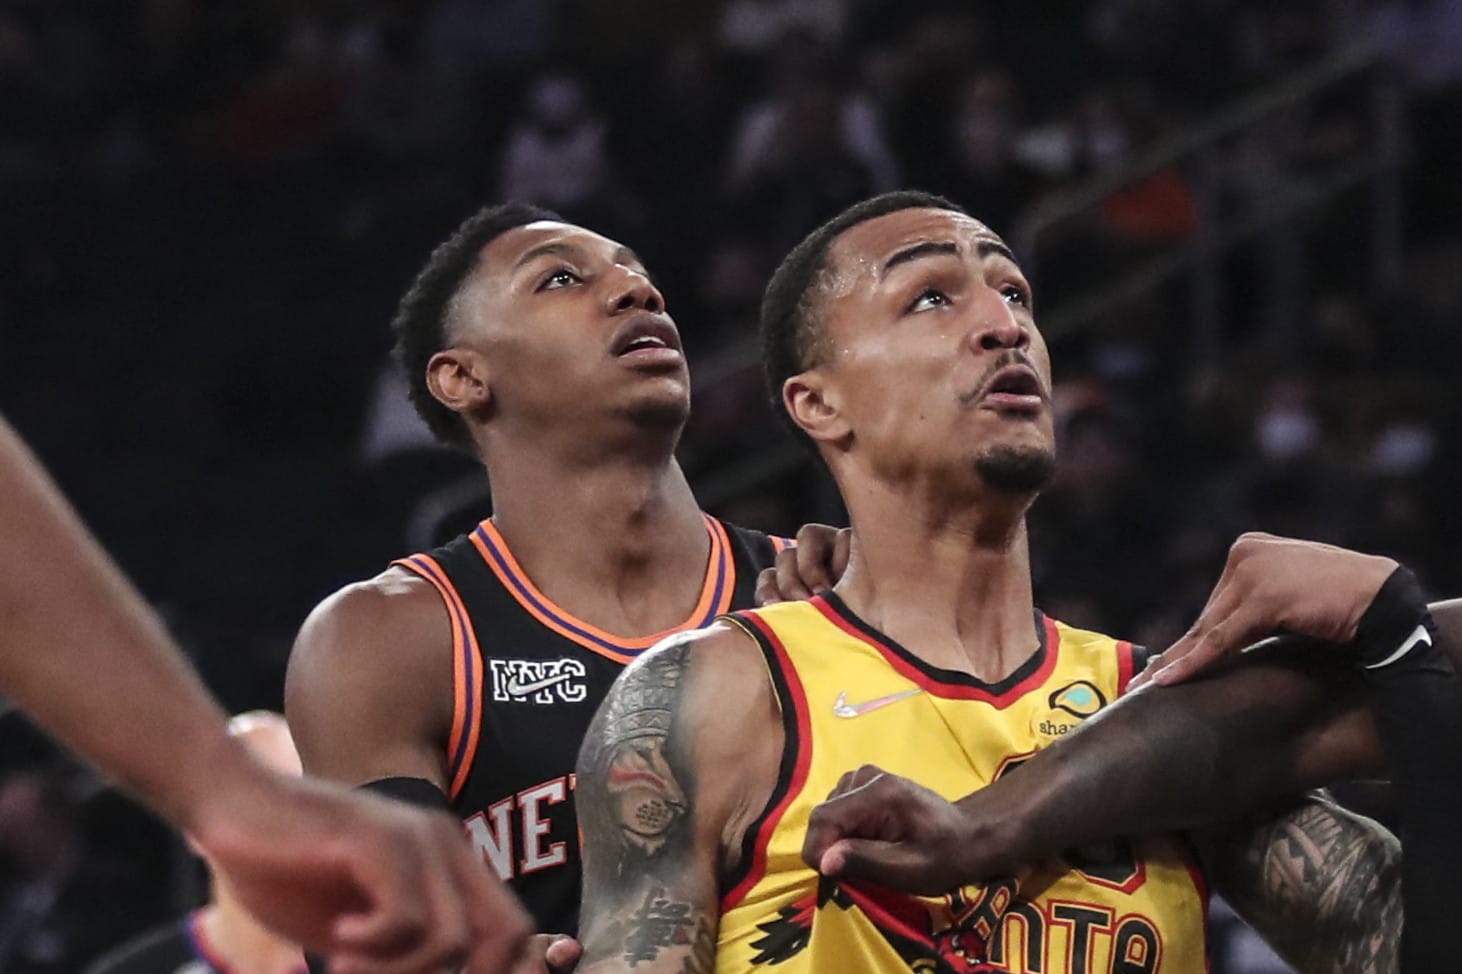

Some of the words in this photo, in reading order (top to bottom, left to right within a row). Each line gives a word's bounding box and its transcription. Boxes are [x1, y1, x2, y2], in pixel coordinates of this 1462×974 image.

[489, 658, 587, 704] NYC
[1039, 719, 1078, 736] sha
[463, 773, 576, 881] NE
